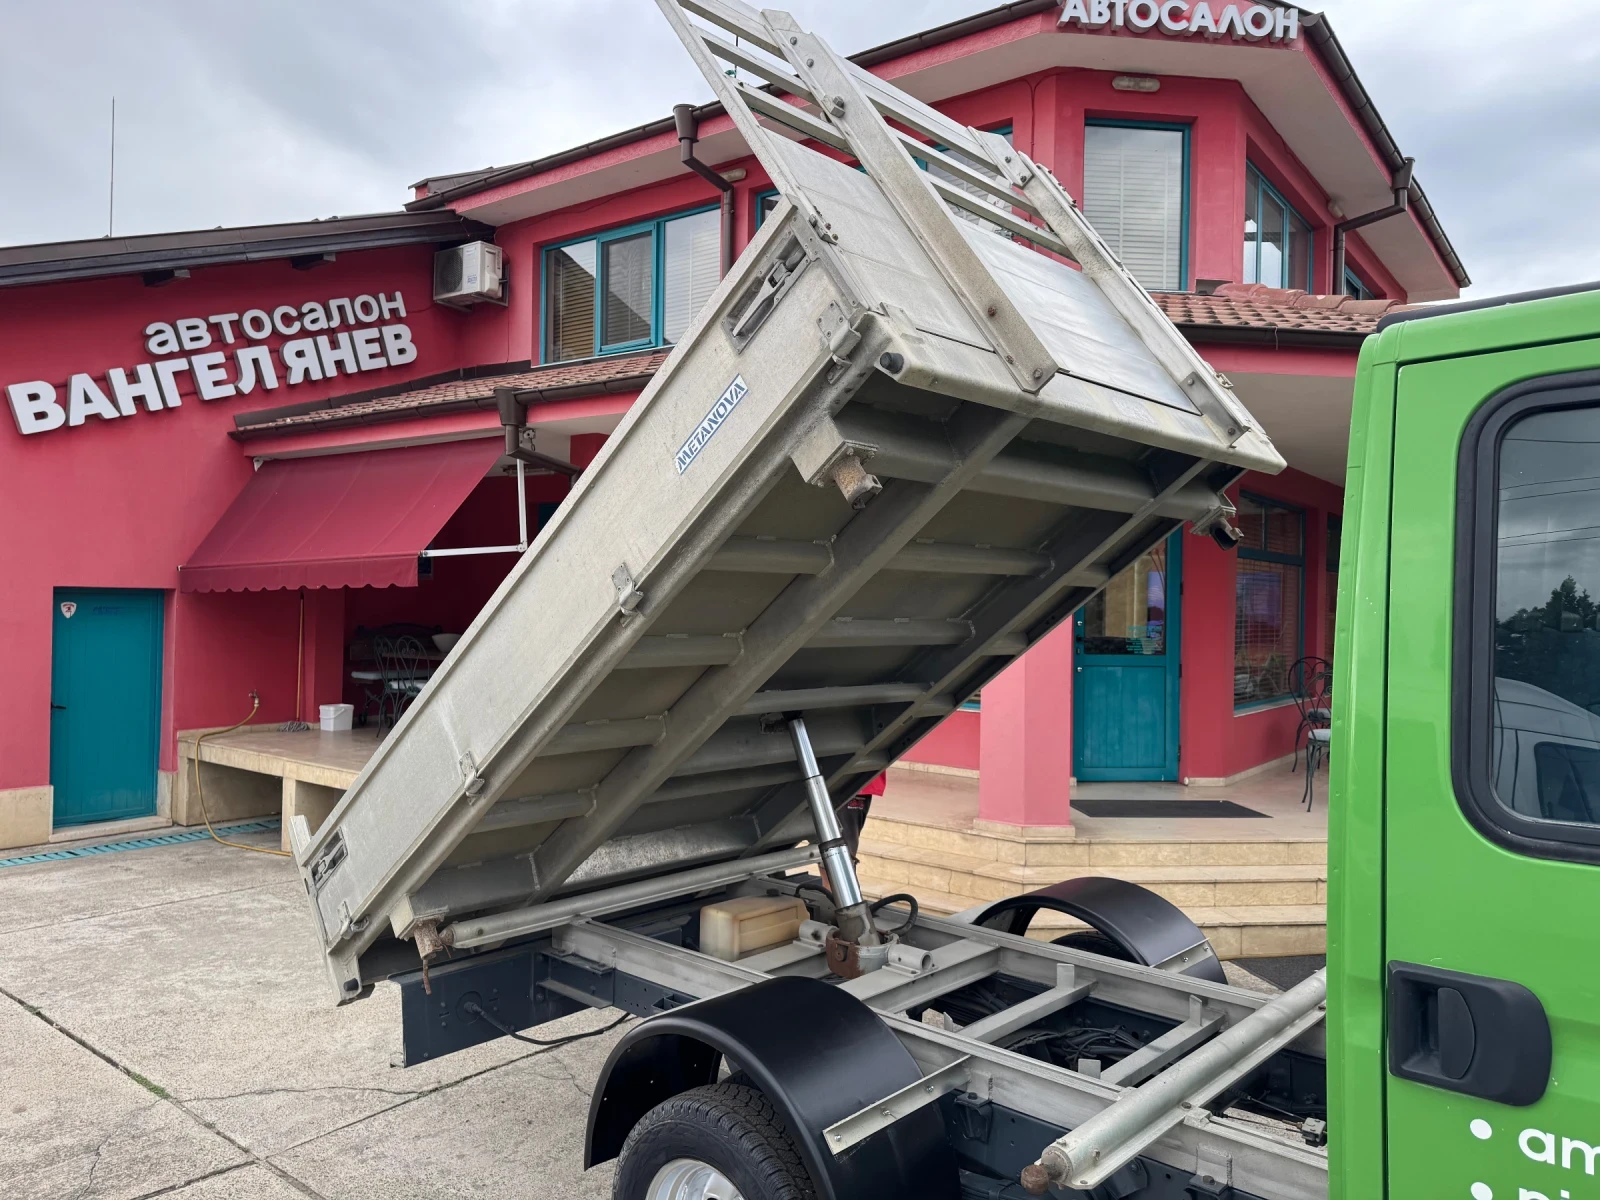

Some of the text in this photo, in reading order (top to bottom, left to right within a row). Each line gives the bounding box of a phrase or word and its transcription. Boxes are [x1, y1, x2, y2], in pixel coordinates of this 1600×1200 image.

[1058, 0, 1299, 41] АВТОСАЛОН
[144, 291, 407, 355] автосалон
[6, 325, 418, 434] ВАНГЕЛ ЯНЕВ
[676, 382, 746, 472] METANOVA
